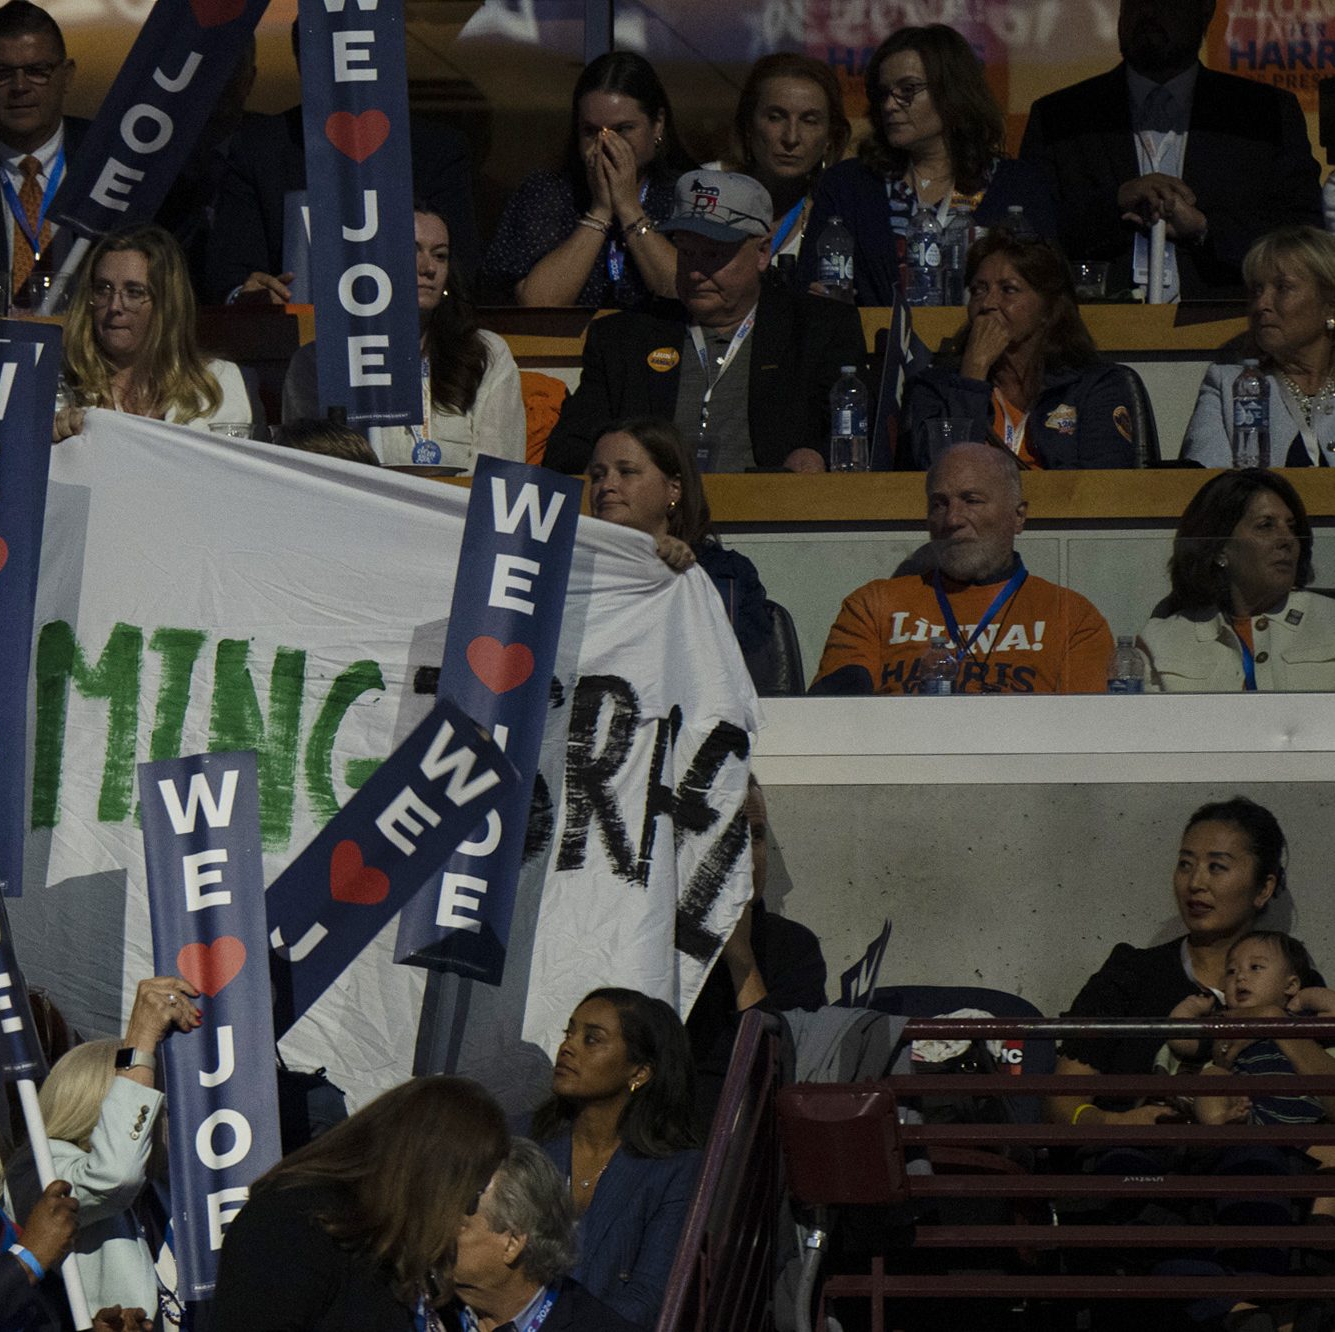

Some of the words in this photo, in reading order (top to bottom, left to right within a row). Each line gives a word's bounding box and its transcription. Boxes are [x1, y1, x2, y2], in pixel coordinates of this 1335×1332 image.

[89, 51, 203, 212] JOE
[338, 190, 394, 387] JOE
[487, 477, 567, 616] WE
[882, 660, 1036, 693] HRIS
[157, 769, 239, 912] WE
[374, 719, 502, 857] WE
